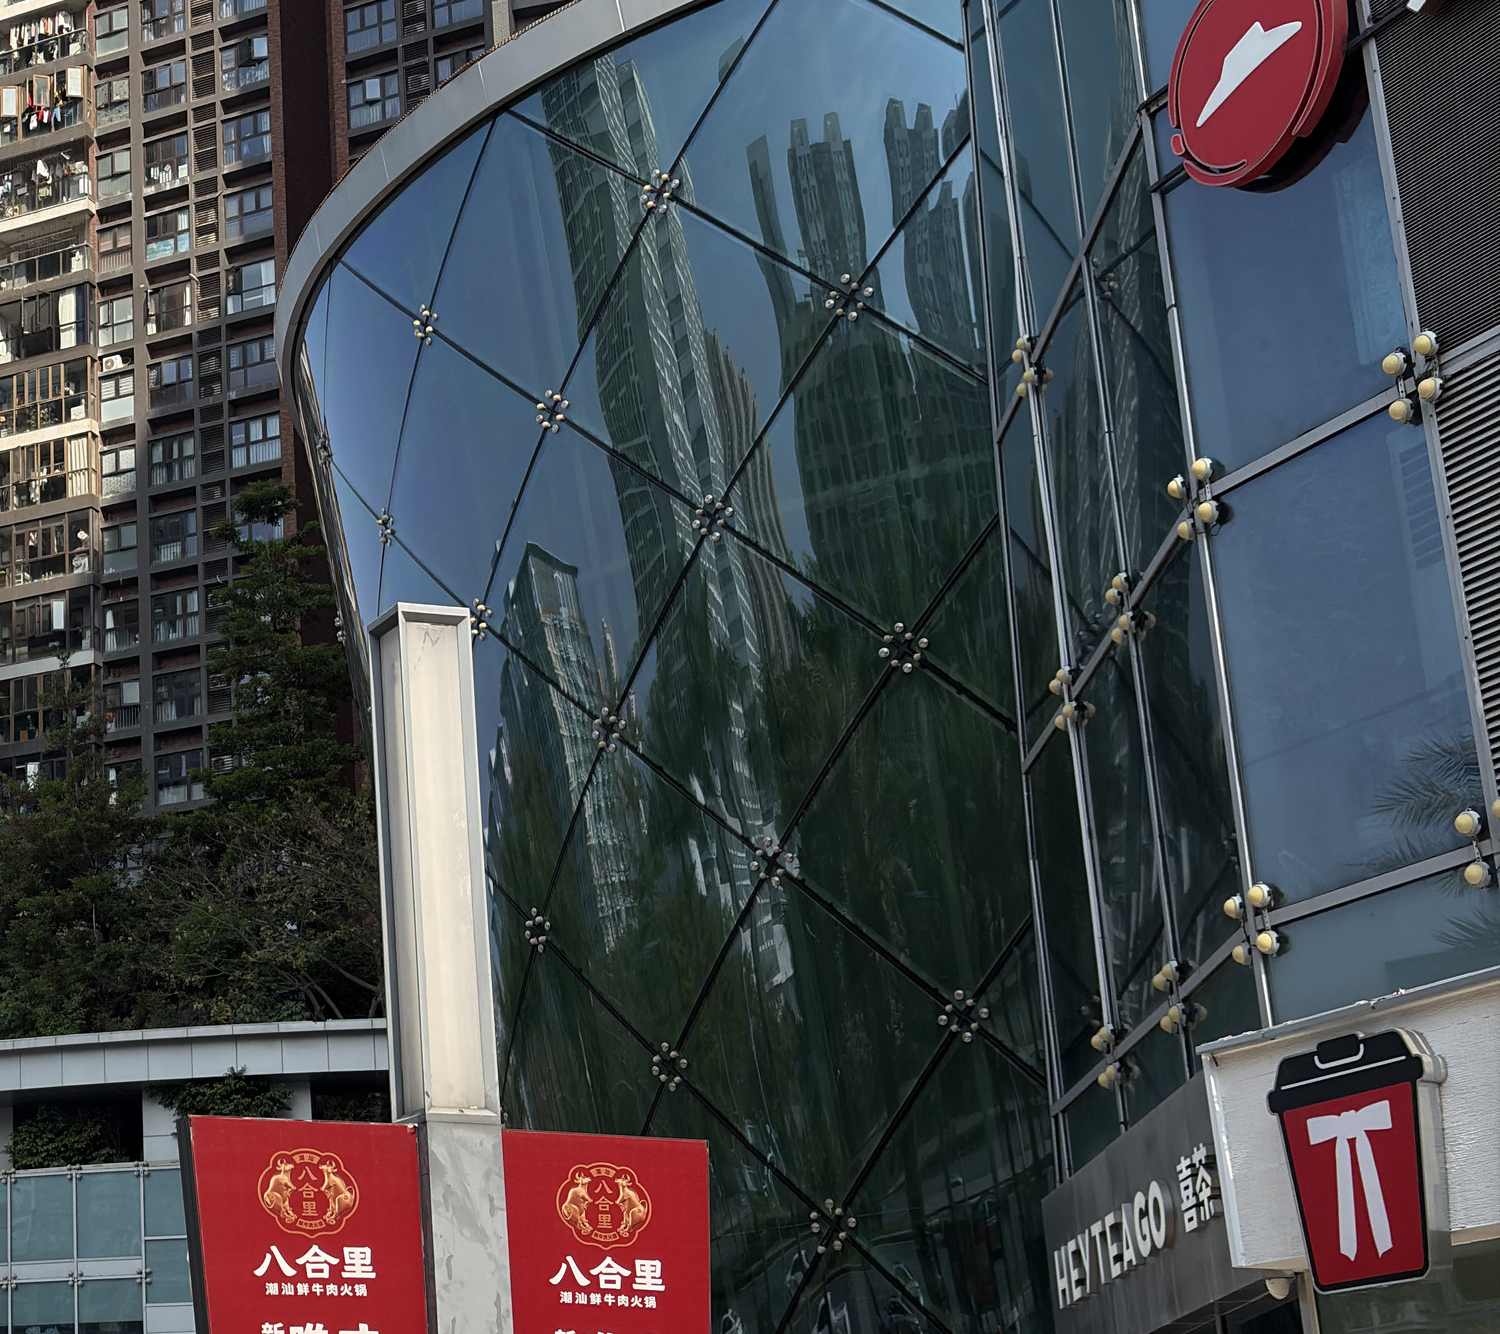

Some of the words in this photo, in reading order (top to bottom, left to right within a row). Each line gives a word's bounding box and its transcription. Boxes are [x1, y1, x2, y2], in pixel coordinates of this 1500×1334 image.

[253, 1244, 376, 1279] 八合里
[1054, 1180, 1166, 1309] HEYTEAGO
[265, 1282, 368, 1297] 潮汕鲜牛肉火锅
[549, 1256, 666, 1291] 八合里
[560, 1291, 657, 1309] 潮汕鲜牛肉火锅
